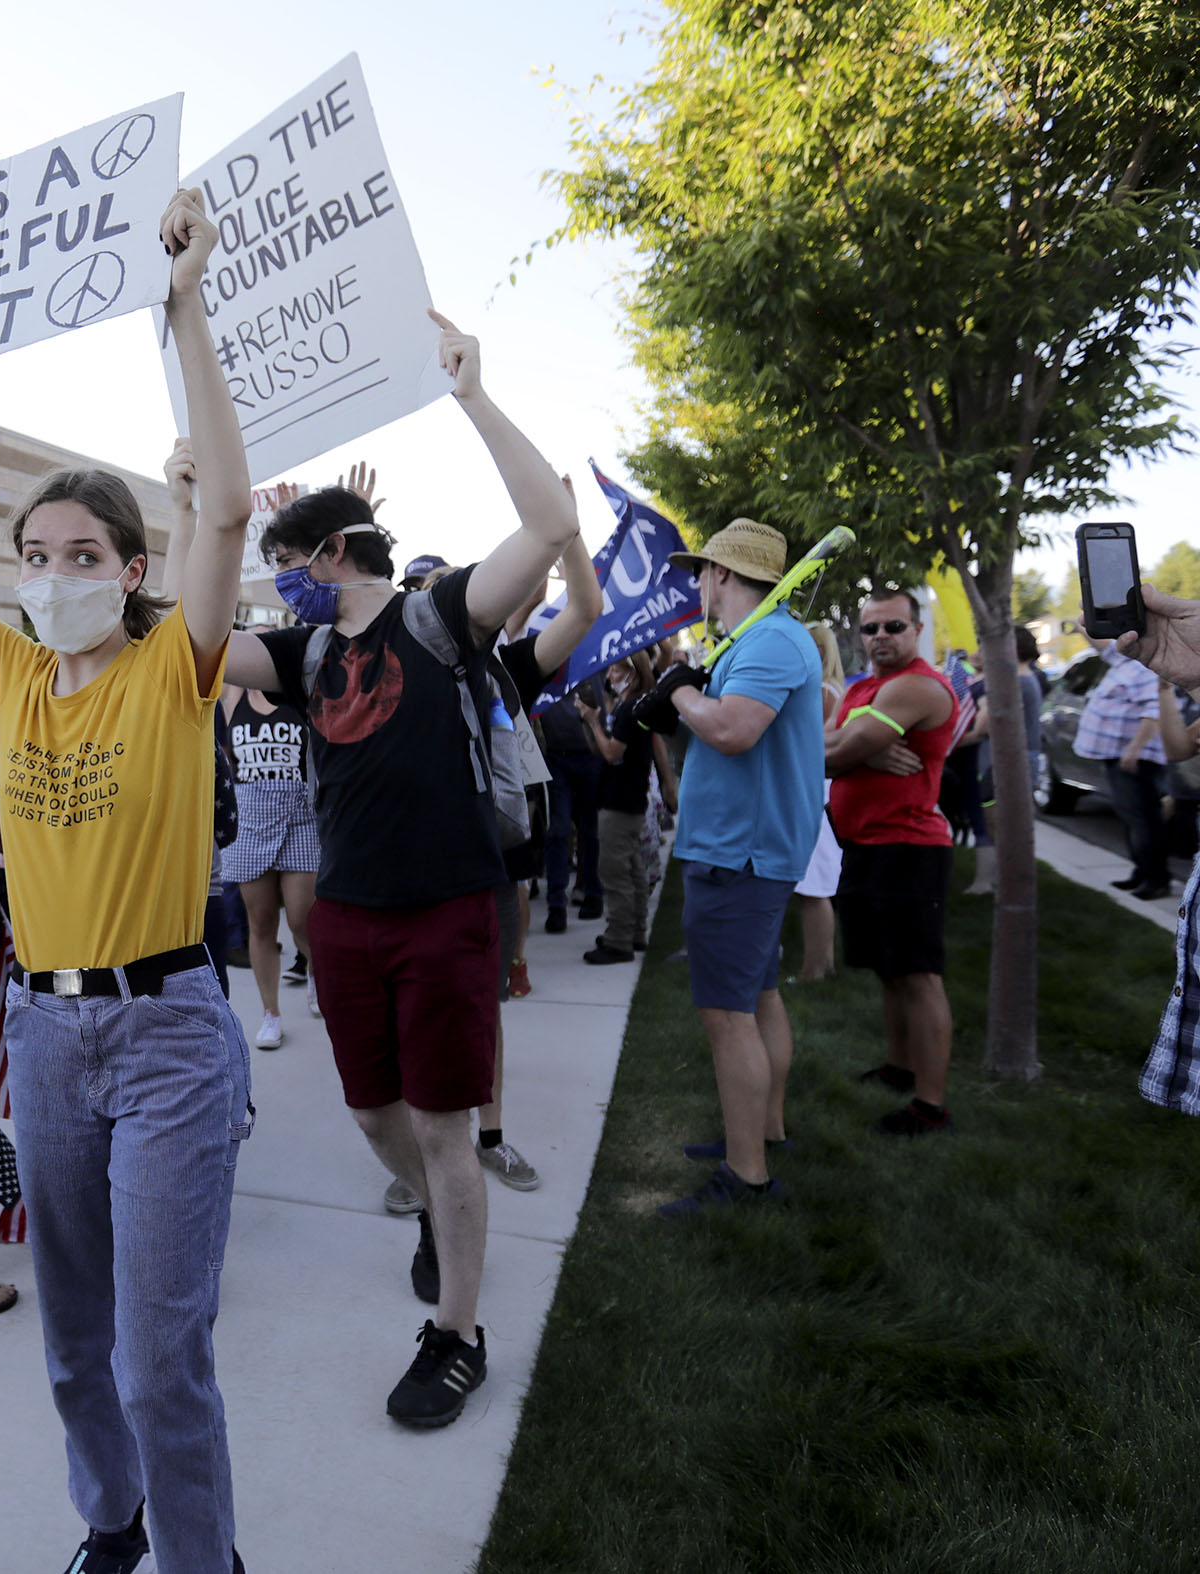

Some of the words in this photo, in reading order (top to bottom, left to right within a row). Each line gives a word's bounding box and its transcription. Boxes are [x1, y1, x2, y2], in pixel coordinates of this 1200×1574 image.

[203, 154, 259, 215] LD
[269, 80, 355, 164] THE
[35, 145, 80, 207] A
[205, 172, 309, 260] OLICE
[162, 170, 395, 349] COUNTABLE
[216, 264, 361, 372] #REMOVE
[226, 322, 350, 408] RUSSO
[232, 722, 303, 746] BLACK
[243, 747, 292, 764] LIVES
[4, 784, 46, 806] WHEN
[68, 782, 119, 808] COULD
[8, 768, 26, 785] OR
[30, 765, 113, 795] TRNSHOBIC
[237, 766, 303, 782] MATTER
[9, 804, 46, 823] JUST
[62, 802, 114, 827] QUIET?
